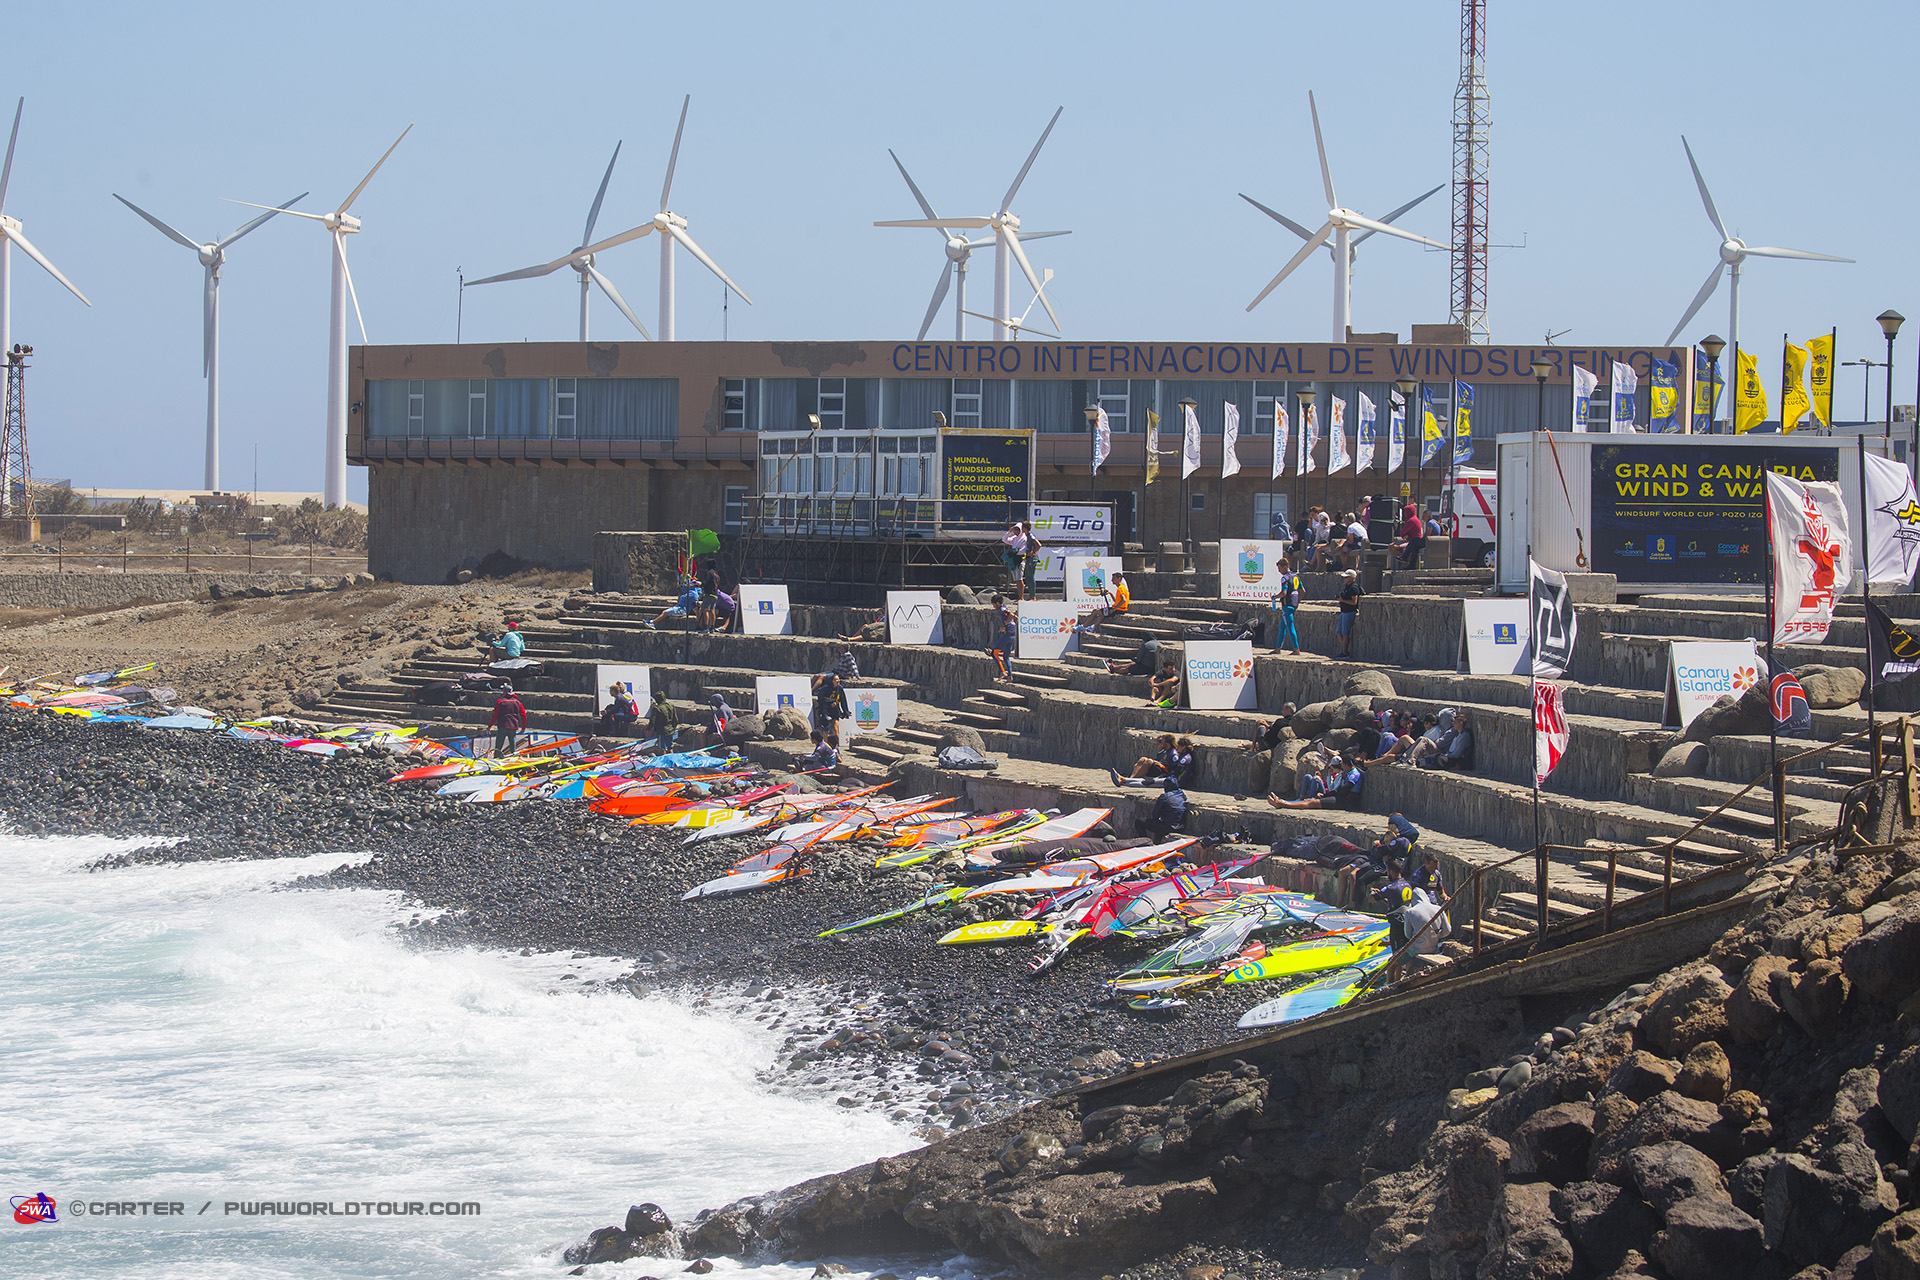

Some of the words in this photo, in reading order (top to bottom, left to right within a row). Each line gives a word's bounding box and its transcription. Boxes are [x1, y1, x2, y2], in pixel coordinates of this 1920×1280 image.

[892, 344, 1021, 373] CENTRO
[1033, 345, 1316, 374] INTERNACIONAL
[1328, 347, 1375, 374] DE
[1389, 347, 1650, 379] WINDSURFING
[953, 456, 991, 464] MUNDIAL
[953, 466, 1011, 474] WINDSURFING
[1615, 463, 1688, 479] GRAN
[953, 475, 976, 483] POZO
[953, 484, 1005, 492] CONCIERTOS
[1615, 481, 1689, 497] WIND
[1699, 482, 1715, 497] &
[1034, 515, 1053, 530] el
[1059, 515, 1105, 531] Taro
[1020, 616, 1057, 628] Canary
[1020, 625, 1058, 634] Islands
[1188, 659, 1231, 671] Canary
[1189, 670, 1232, 680] Islands
[1677, 666, 1730, 682] Canary
[1679, 680, 1731, 692] Islands
